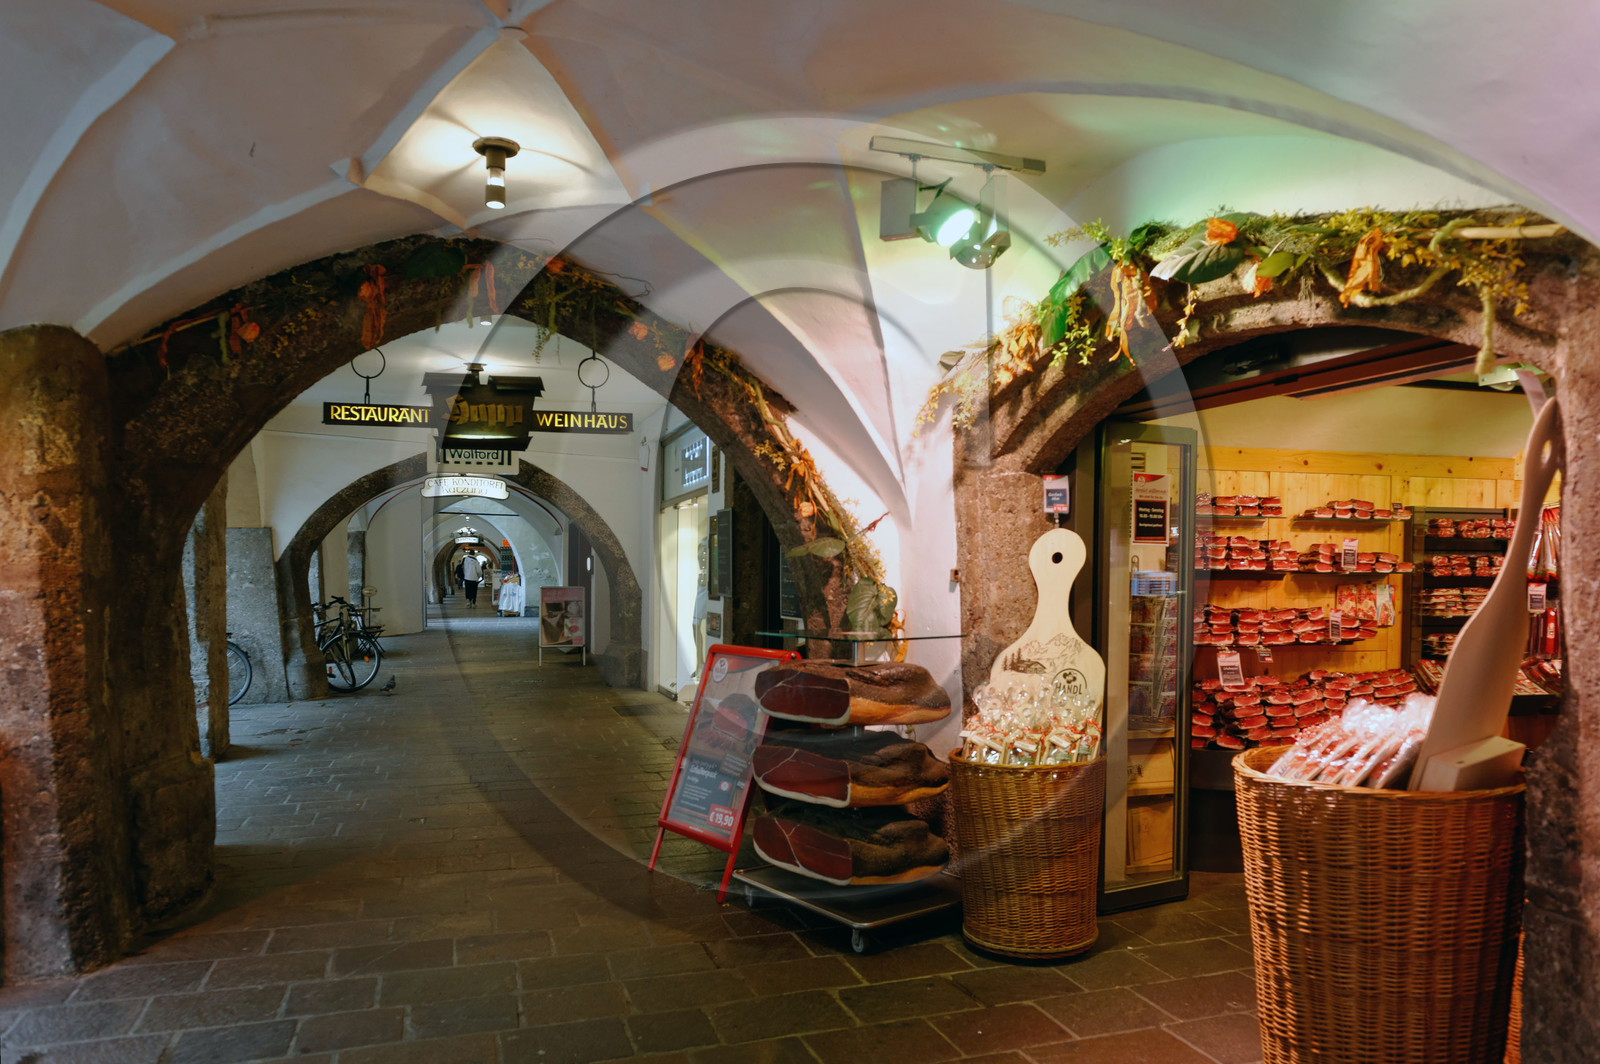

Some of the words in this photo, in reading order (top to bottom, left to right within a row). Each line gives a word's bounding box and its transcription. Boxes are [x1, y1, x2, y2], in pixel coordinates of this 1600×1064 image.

[330, 405, 431, 423] RESTAURANT
[536, 413, 628, 429] WEINHAUS
[448, 449, 499, 460] Wolford
[452, 478, 504, 489] KONDITOREI
[1055, 682, 1082, 695] HANDL
